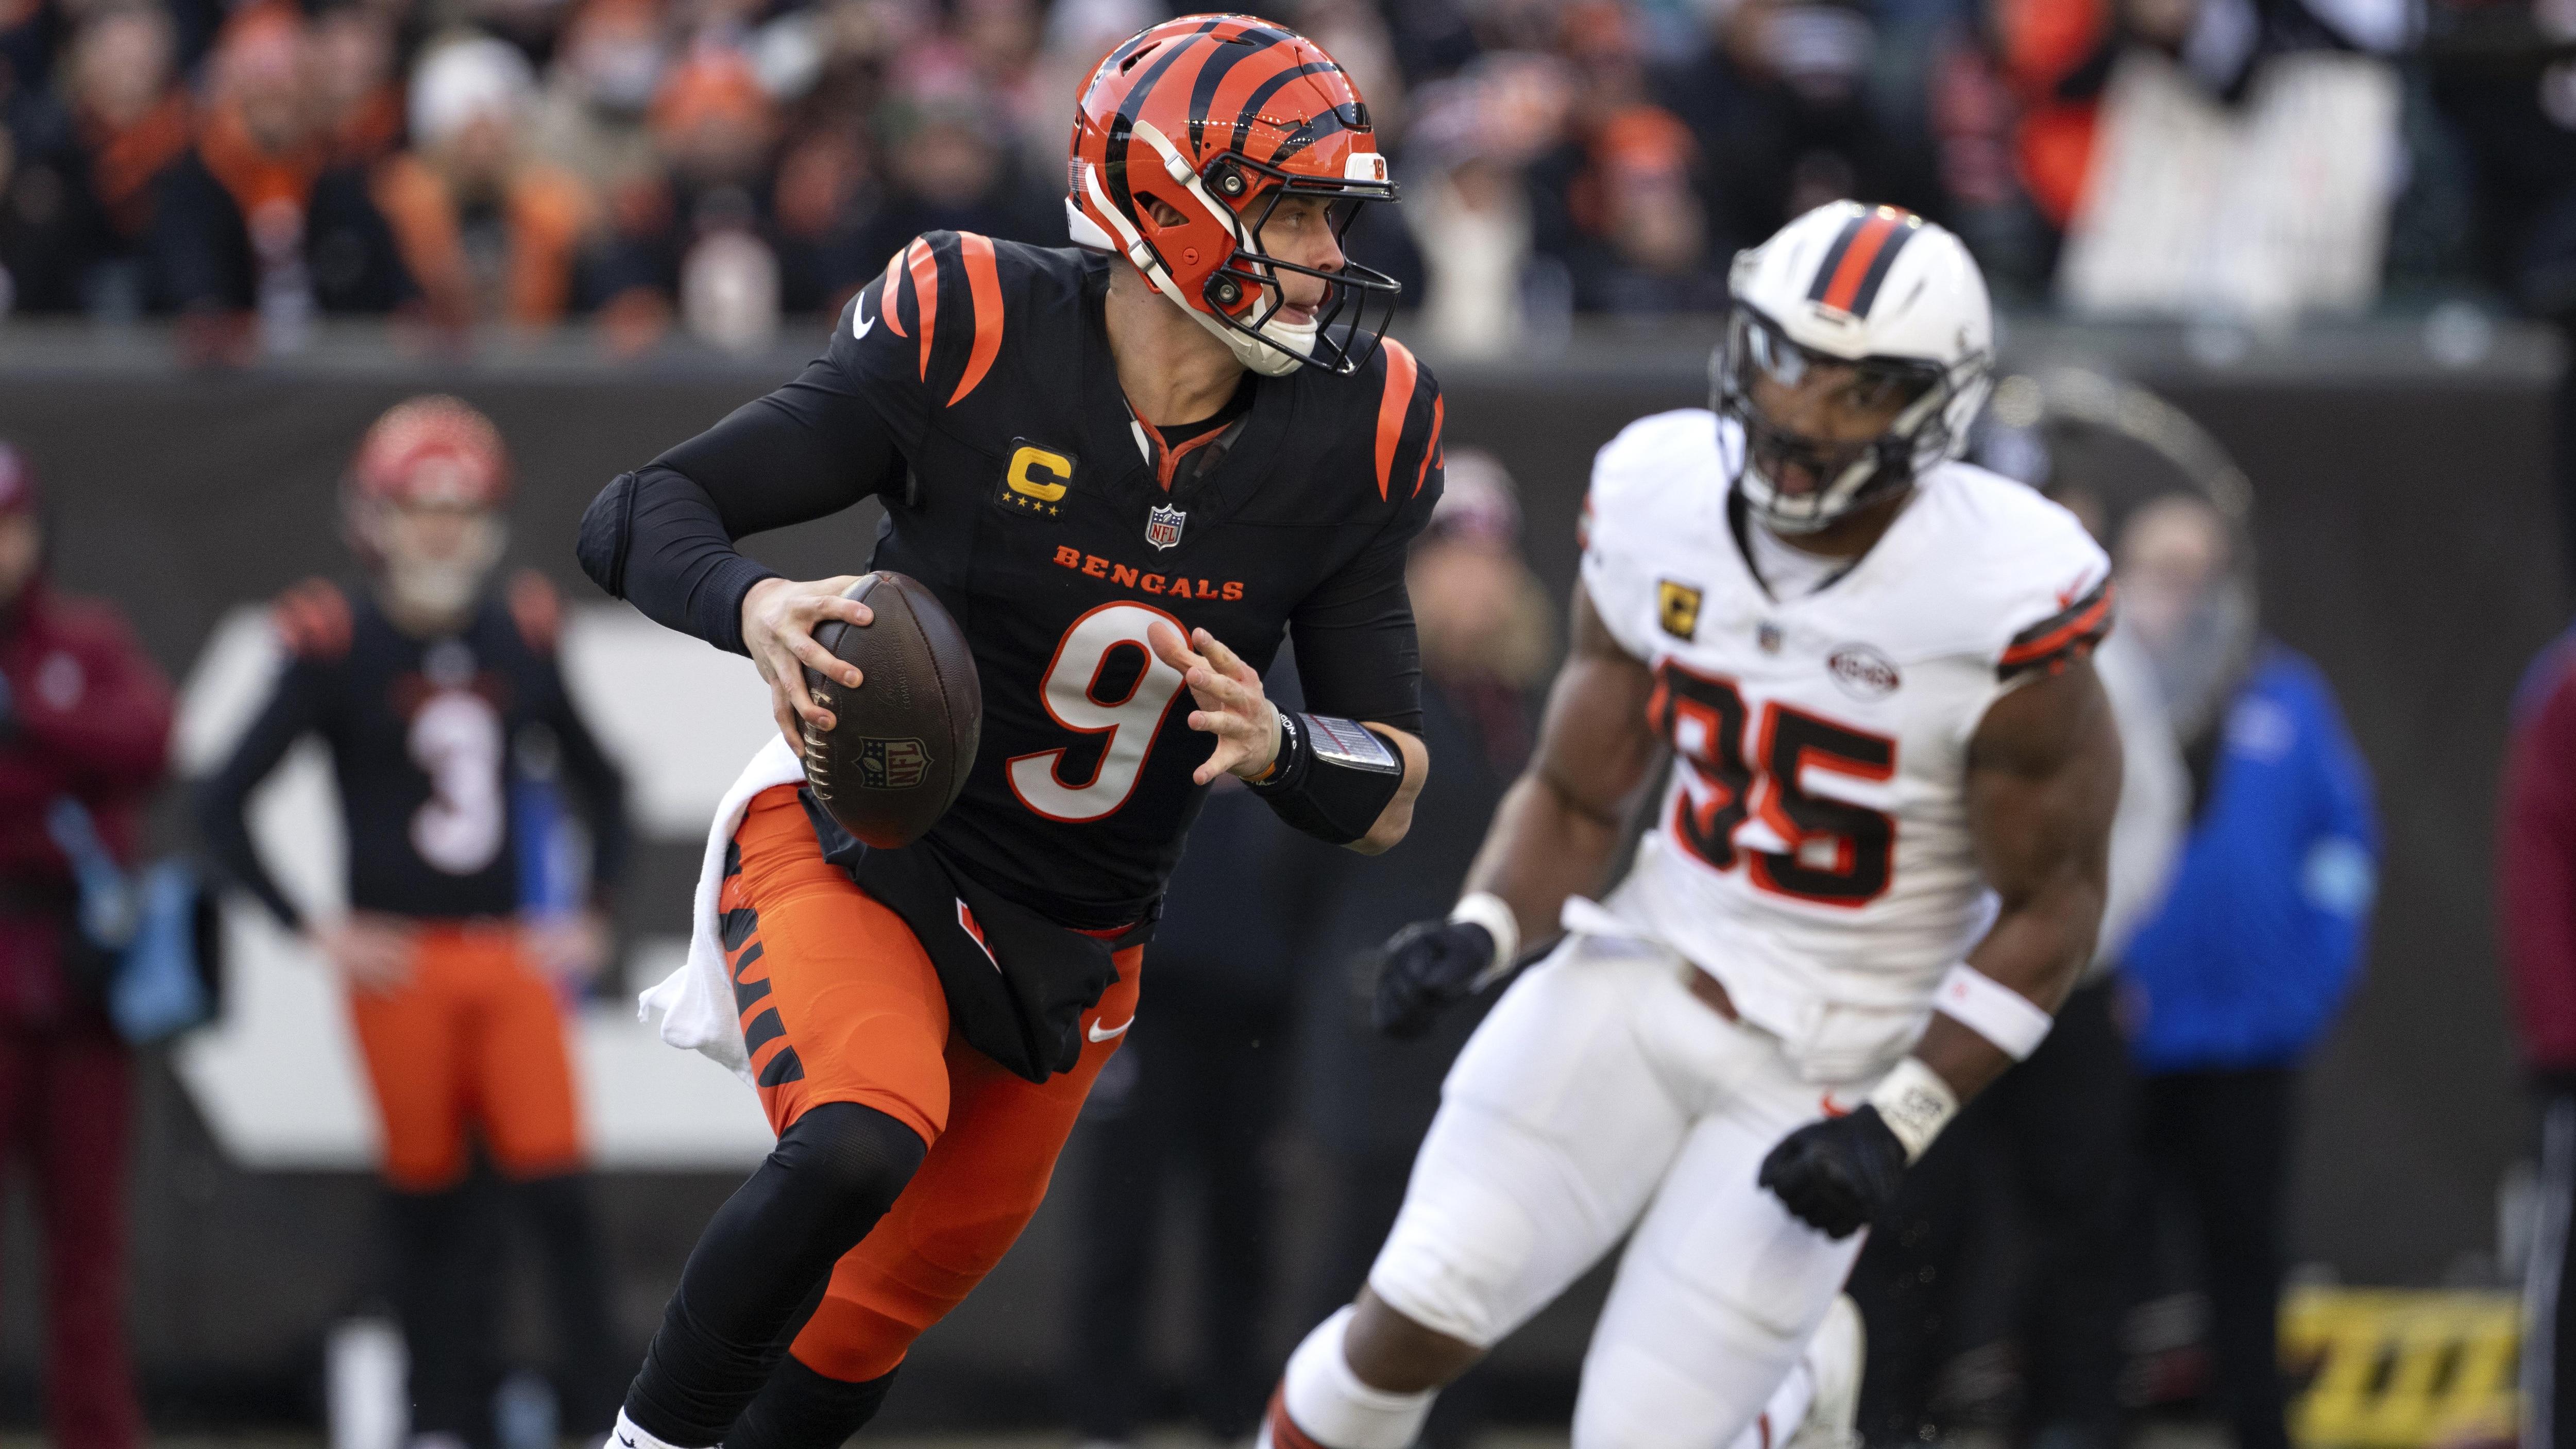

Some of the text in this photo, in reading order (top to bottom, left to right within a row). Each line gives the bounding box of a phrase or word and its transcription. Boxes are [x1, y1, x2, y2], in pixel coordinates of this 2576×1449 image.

[1007, 446, 1072, 502] C
[1151, 523, 1175, 543] NFL
[1053, 545, 1244, 601] BENGALS
[1007, 600, 1194, 823] 9
[407, 692, 506, 875] 3
[888, 744, 923, 785] NFL
[1648, 656, 1897, 909] 95
